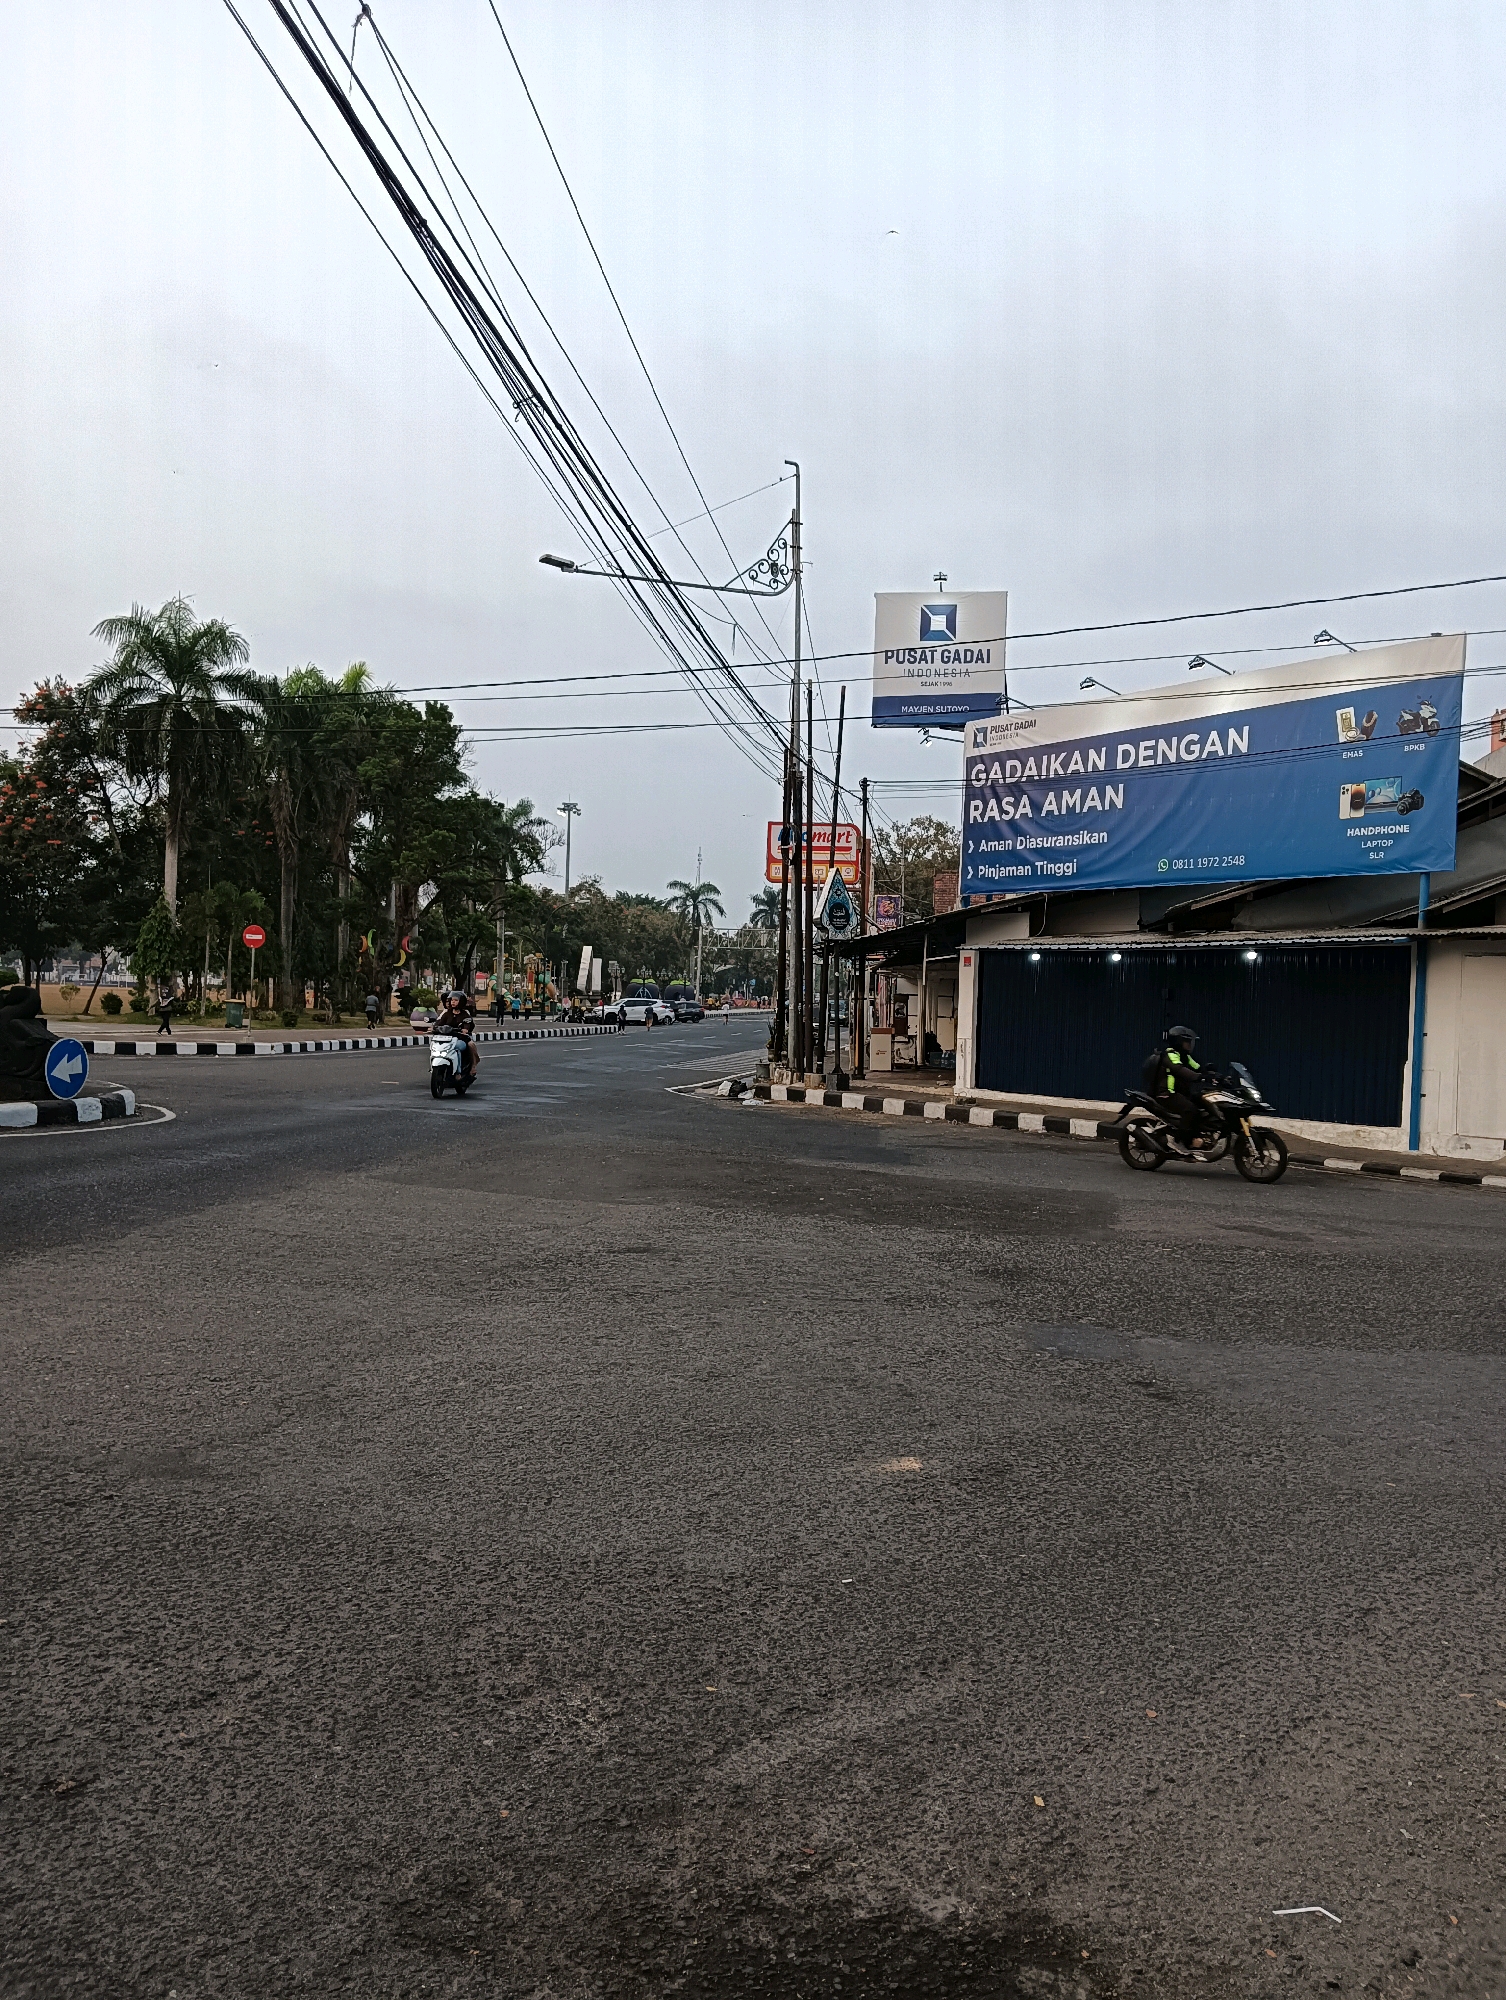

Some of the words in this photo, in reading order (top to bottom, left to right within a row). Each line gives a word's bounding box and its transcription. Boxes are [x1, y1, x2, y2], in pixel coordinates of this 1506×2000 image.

[885, 649, 938, 665] PUSAT
[940, 648, 991, 664] GADAI
[903, 668, 971, 678] INDONESIA
[901, 706, 934, 714] MAYJEN
[935, 705, 970, 714] SUTOYO
[990, 722, 1014, 734] PUSAT
[1014, 719, 1037, 730] GADAI
[1342, 750, 1364, 759] EMAS
[1404, 743, 1426, 752] BPKB
[970, 746, 1107, 788] GADAIKAN
[1116, 725, 1250, 770] DENGAN
[969, 794, 1033, 824] RASA
[1040, 783, 1125, 817] AMAN
[1346, 824, 1410, 837] HANDPHONE
[978, 838, 1013, 852] Aman
[1016, 830, 1108, 850] Diasuransikan
[1361, 839, 1394, 848] LAPTOP
[1172, 858, 1195, 870] 0811
[1197, 857, 1220, 868] 1972
[1222, 855, 1246, 867] 2548
[1369, 851, 1385, 860] SLR
[977, 863, 1032, 880] Pinjaman
[1035, 859, 1077, 878] Tinggi
